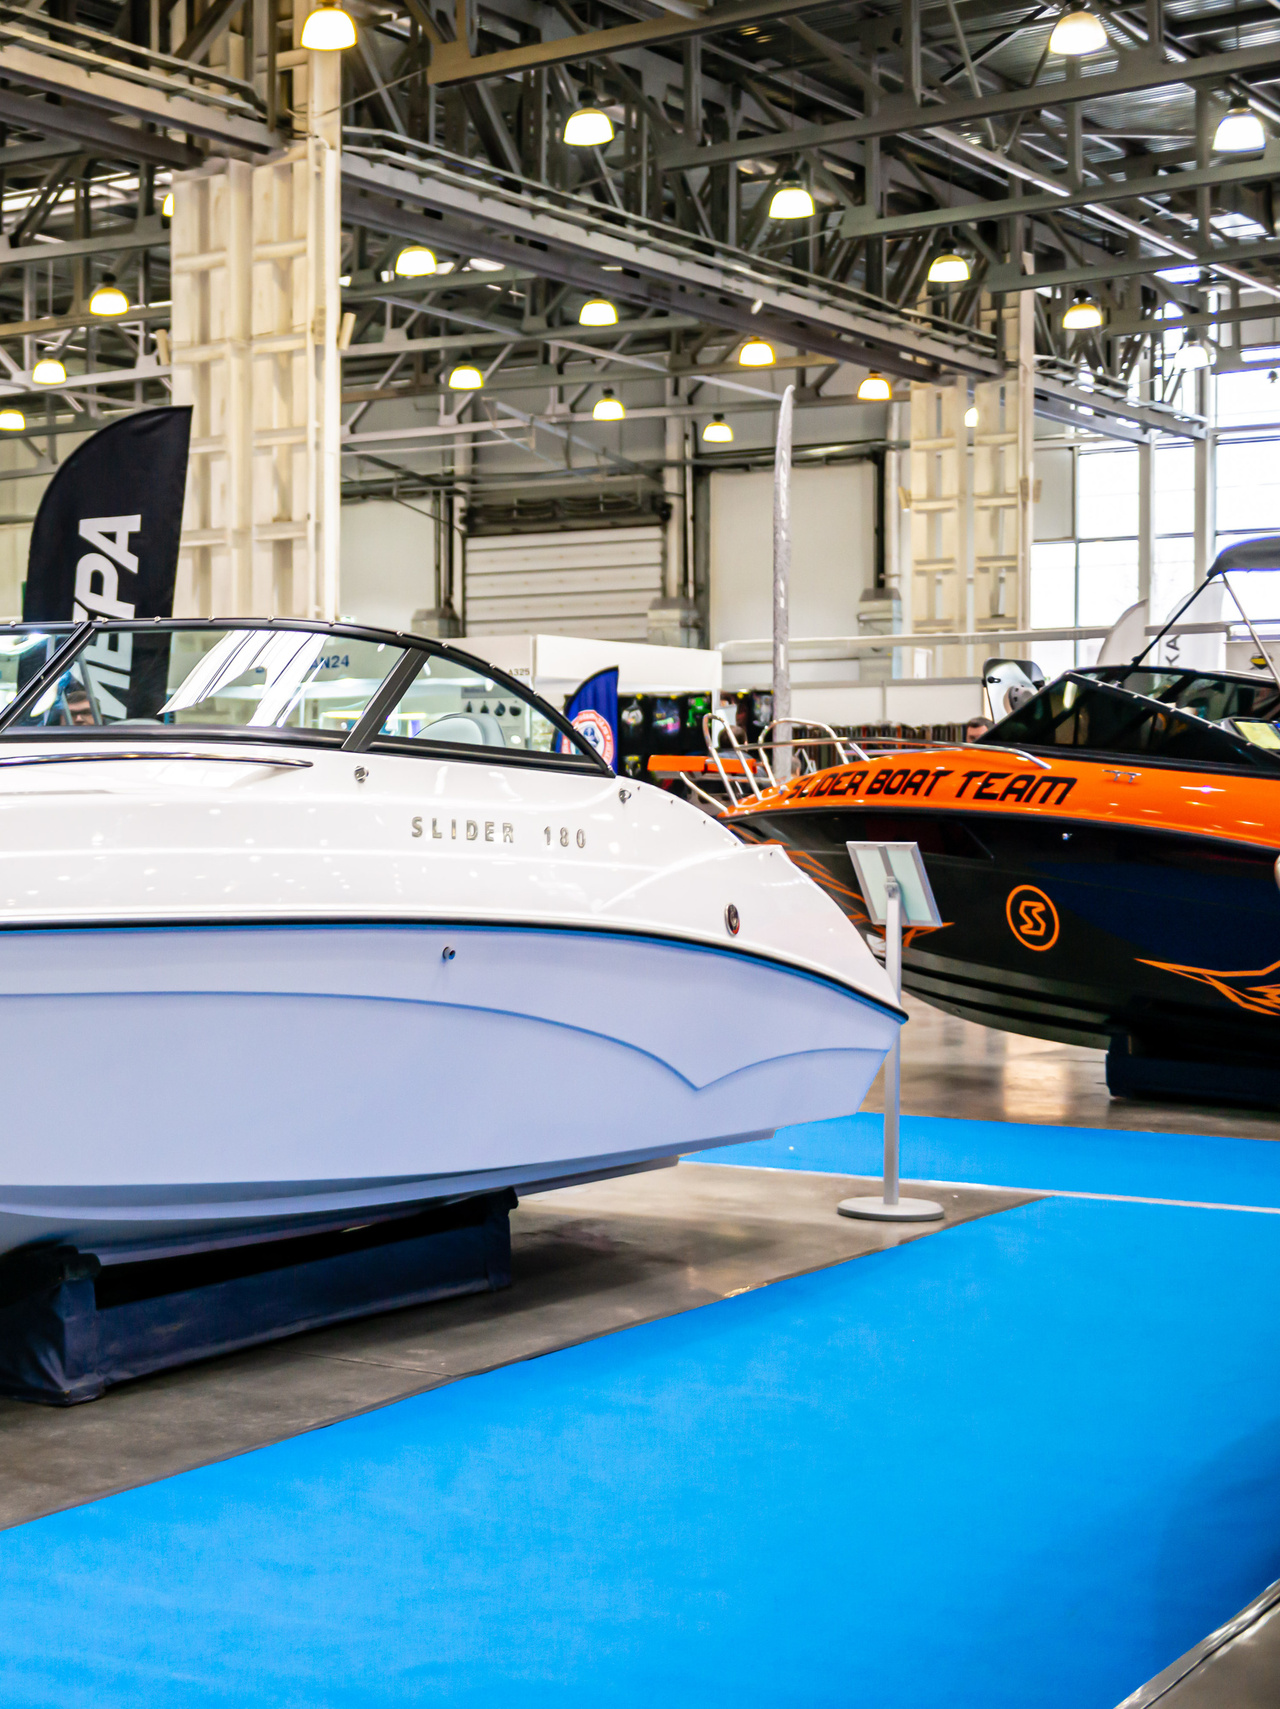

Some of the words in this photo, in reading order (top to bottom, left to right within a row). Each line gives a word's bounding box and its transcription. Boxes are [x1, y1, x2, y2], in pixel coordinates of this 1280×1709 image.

[786, 770, 870, 800] SLIDER
[865, 769, 954, 797] BOAT
[955, 771, 1078, 805] TEAM
[411, 816, 514, 843] SLIDER
[543, 826, 587, 849] 180
